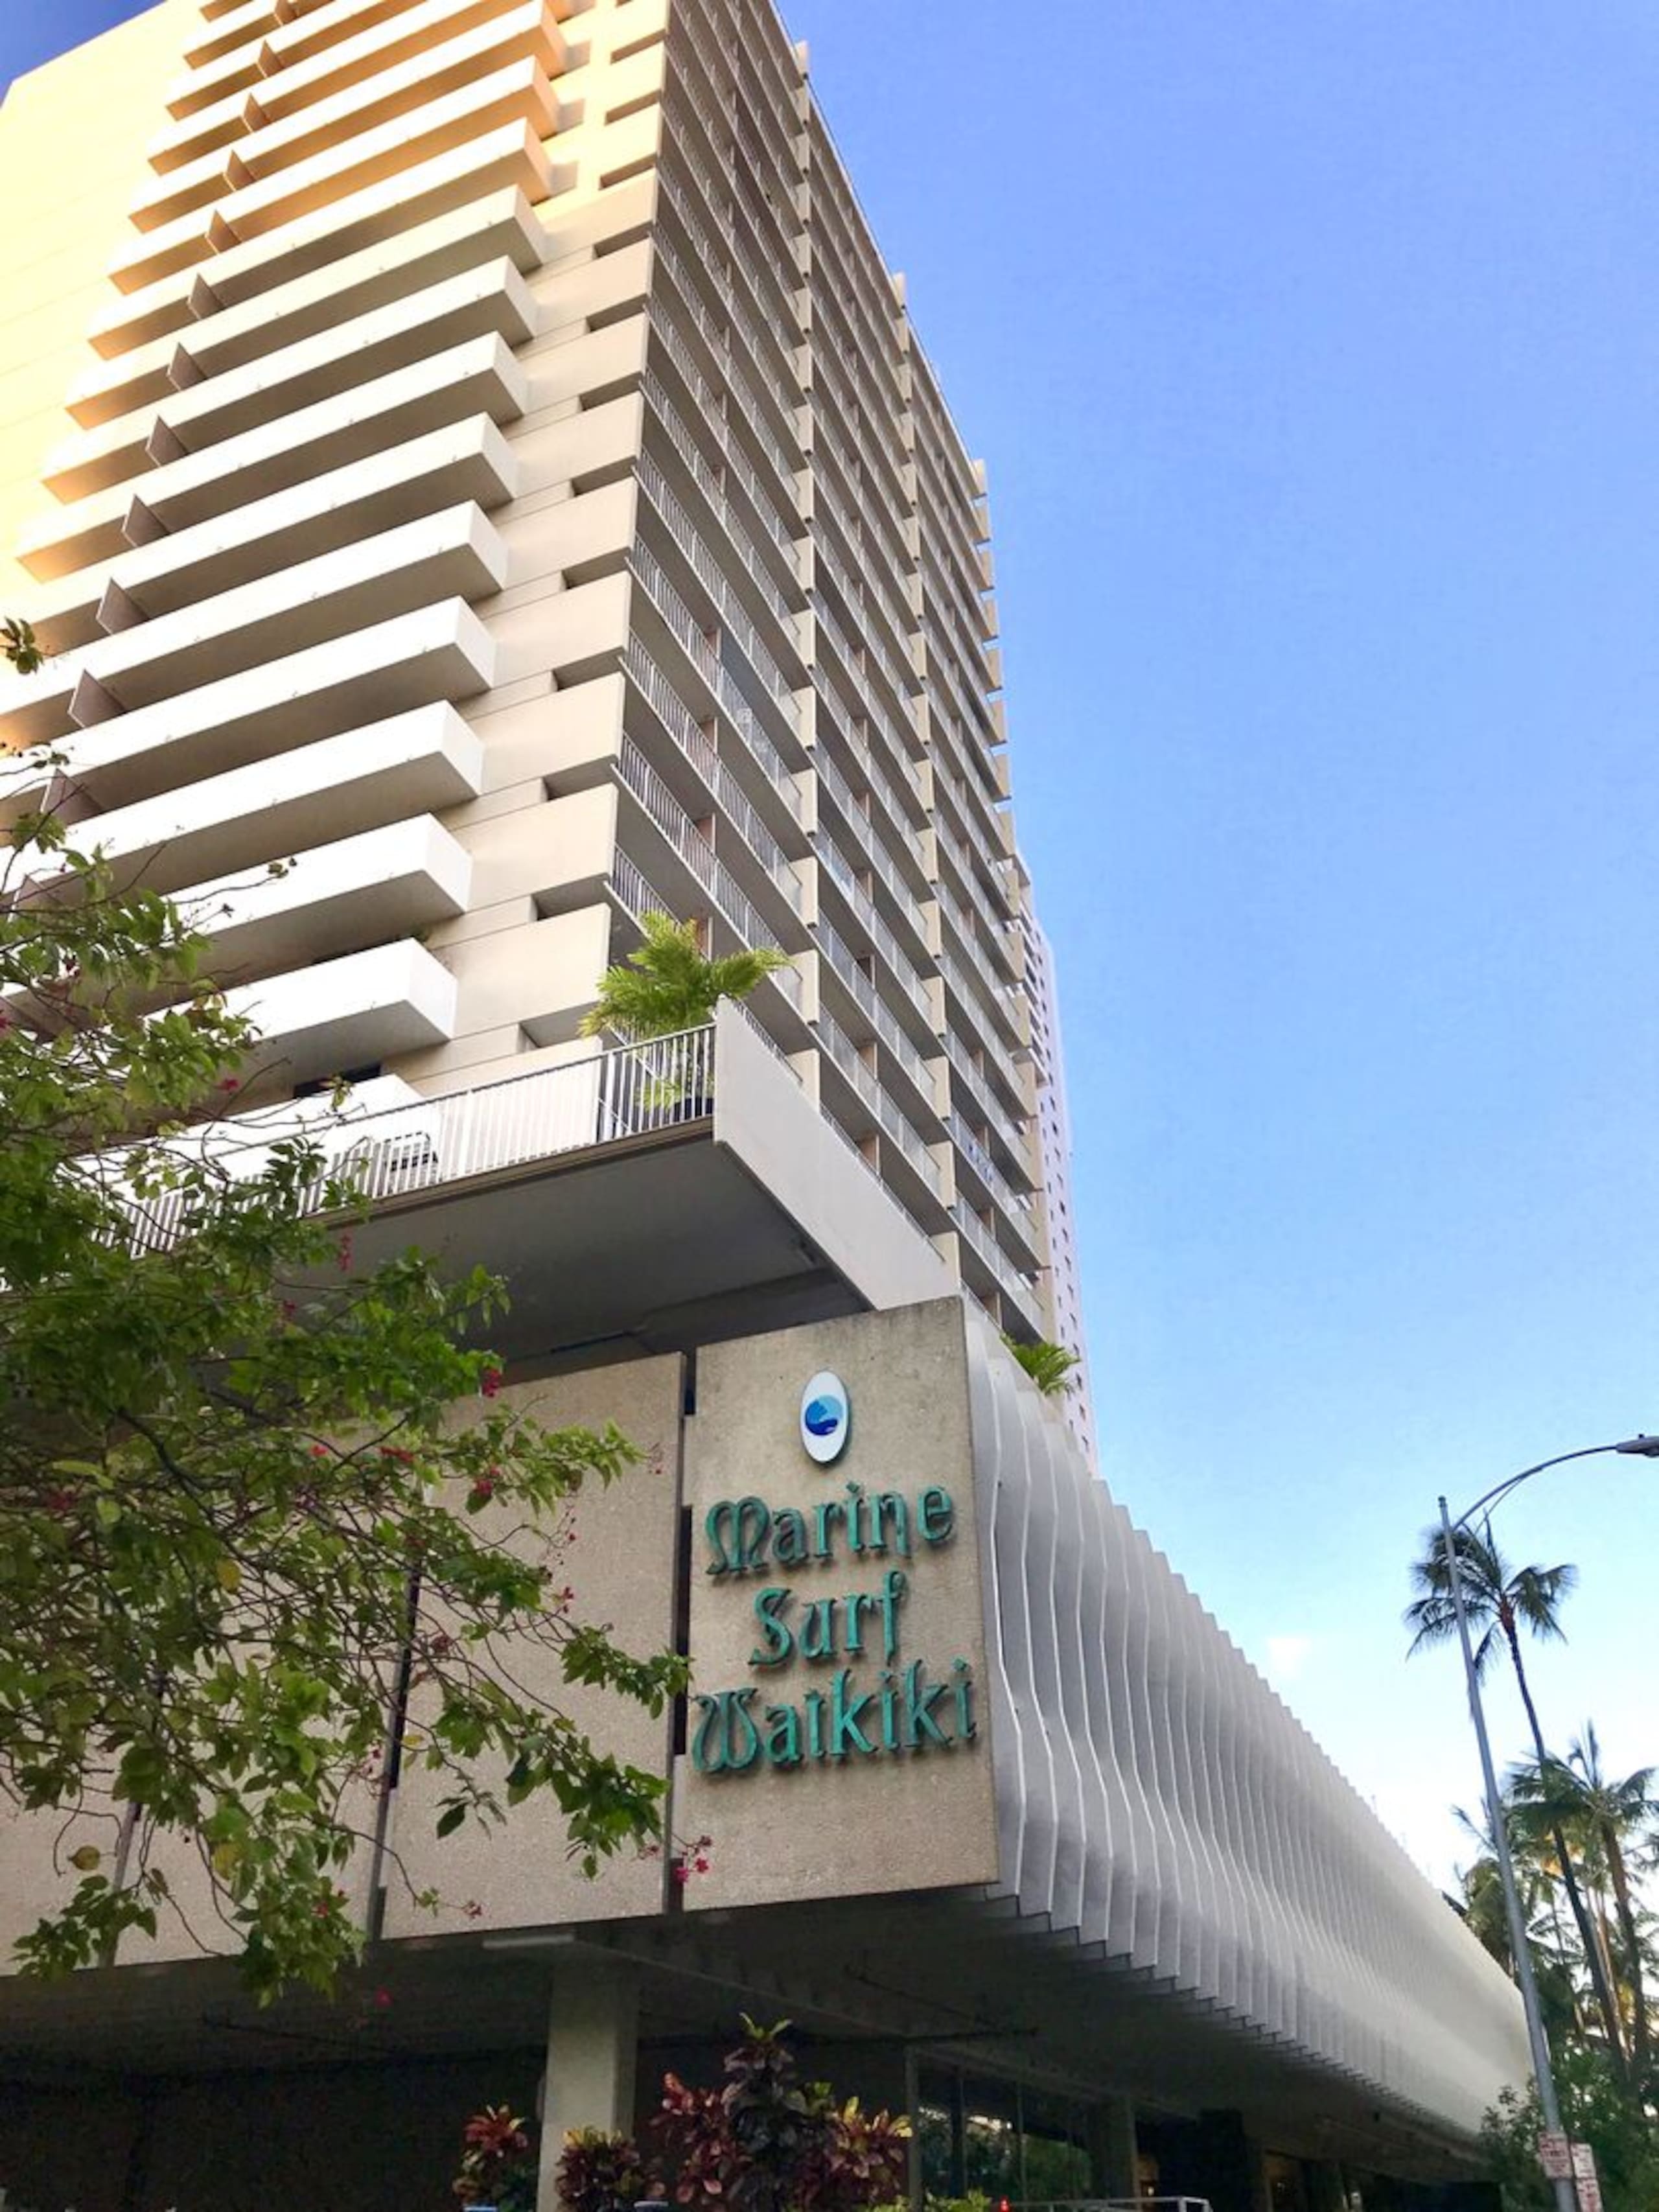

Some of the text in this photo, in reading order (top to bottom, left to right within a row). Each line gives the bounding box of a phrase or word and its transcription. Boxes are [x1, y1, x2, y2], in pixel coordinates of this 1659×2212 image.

[704, 1481, 953, 1574] Marine
[748, 1570, 906, 1665] Surf
[689, 1657, 976, 1773] Waikiki
